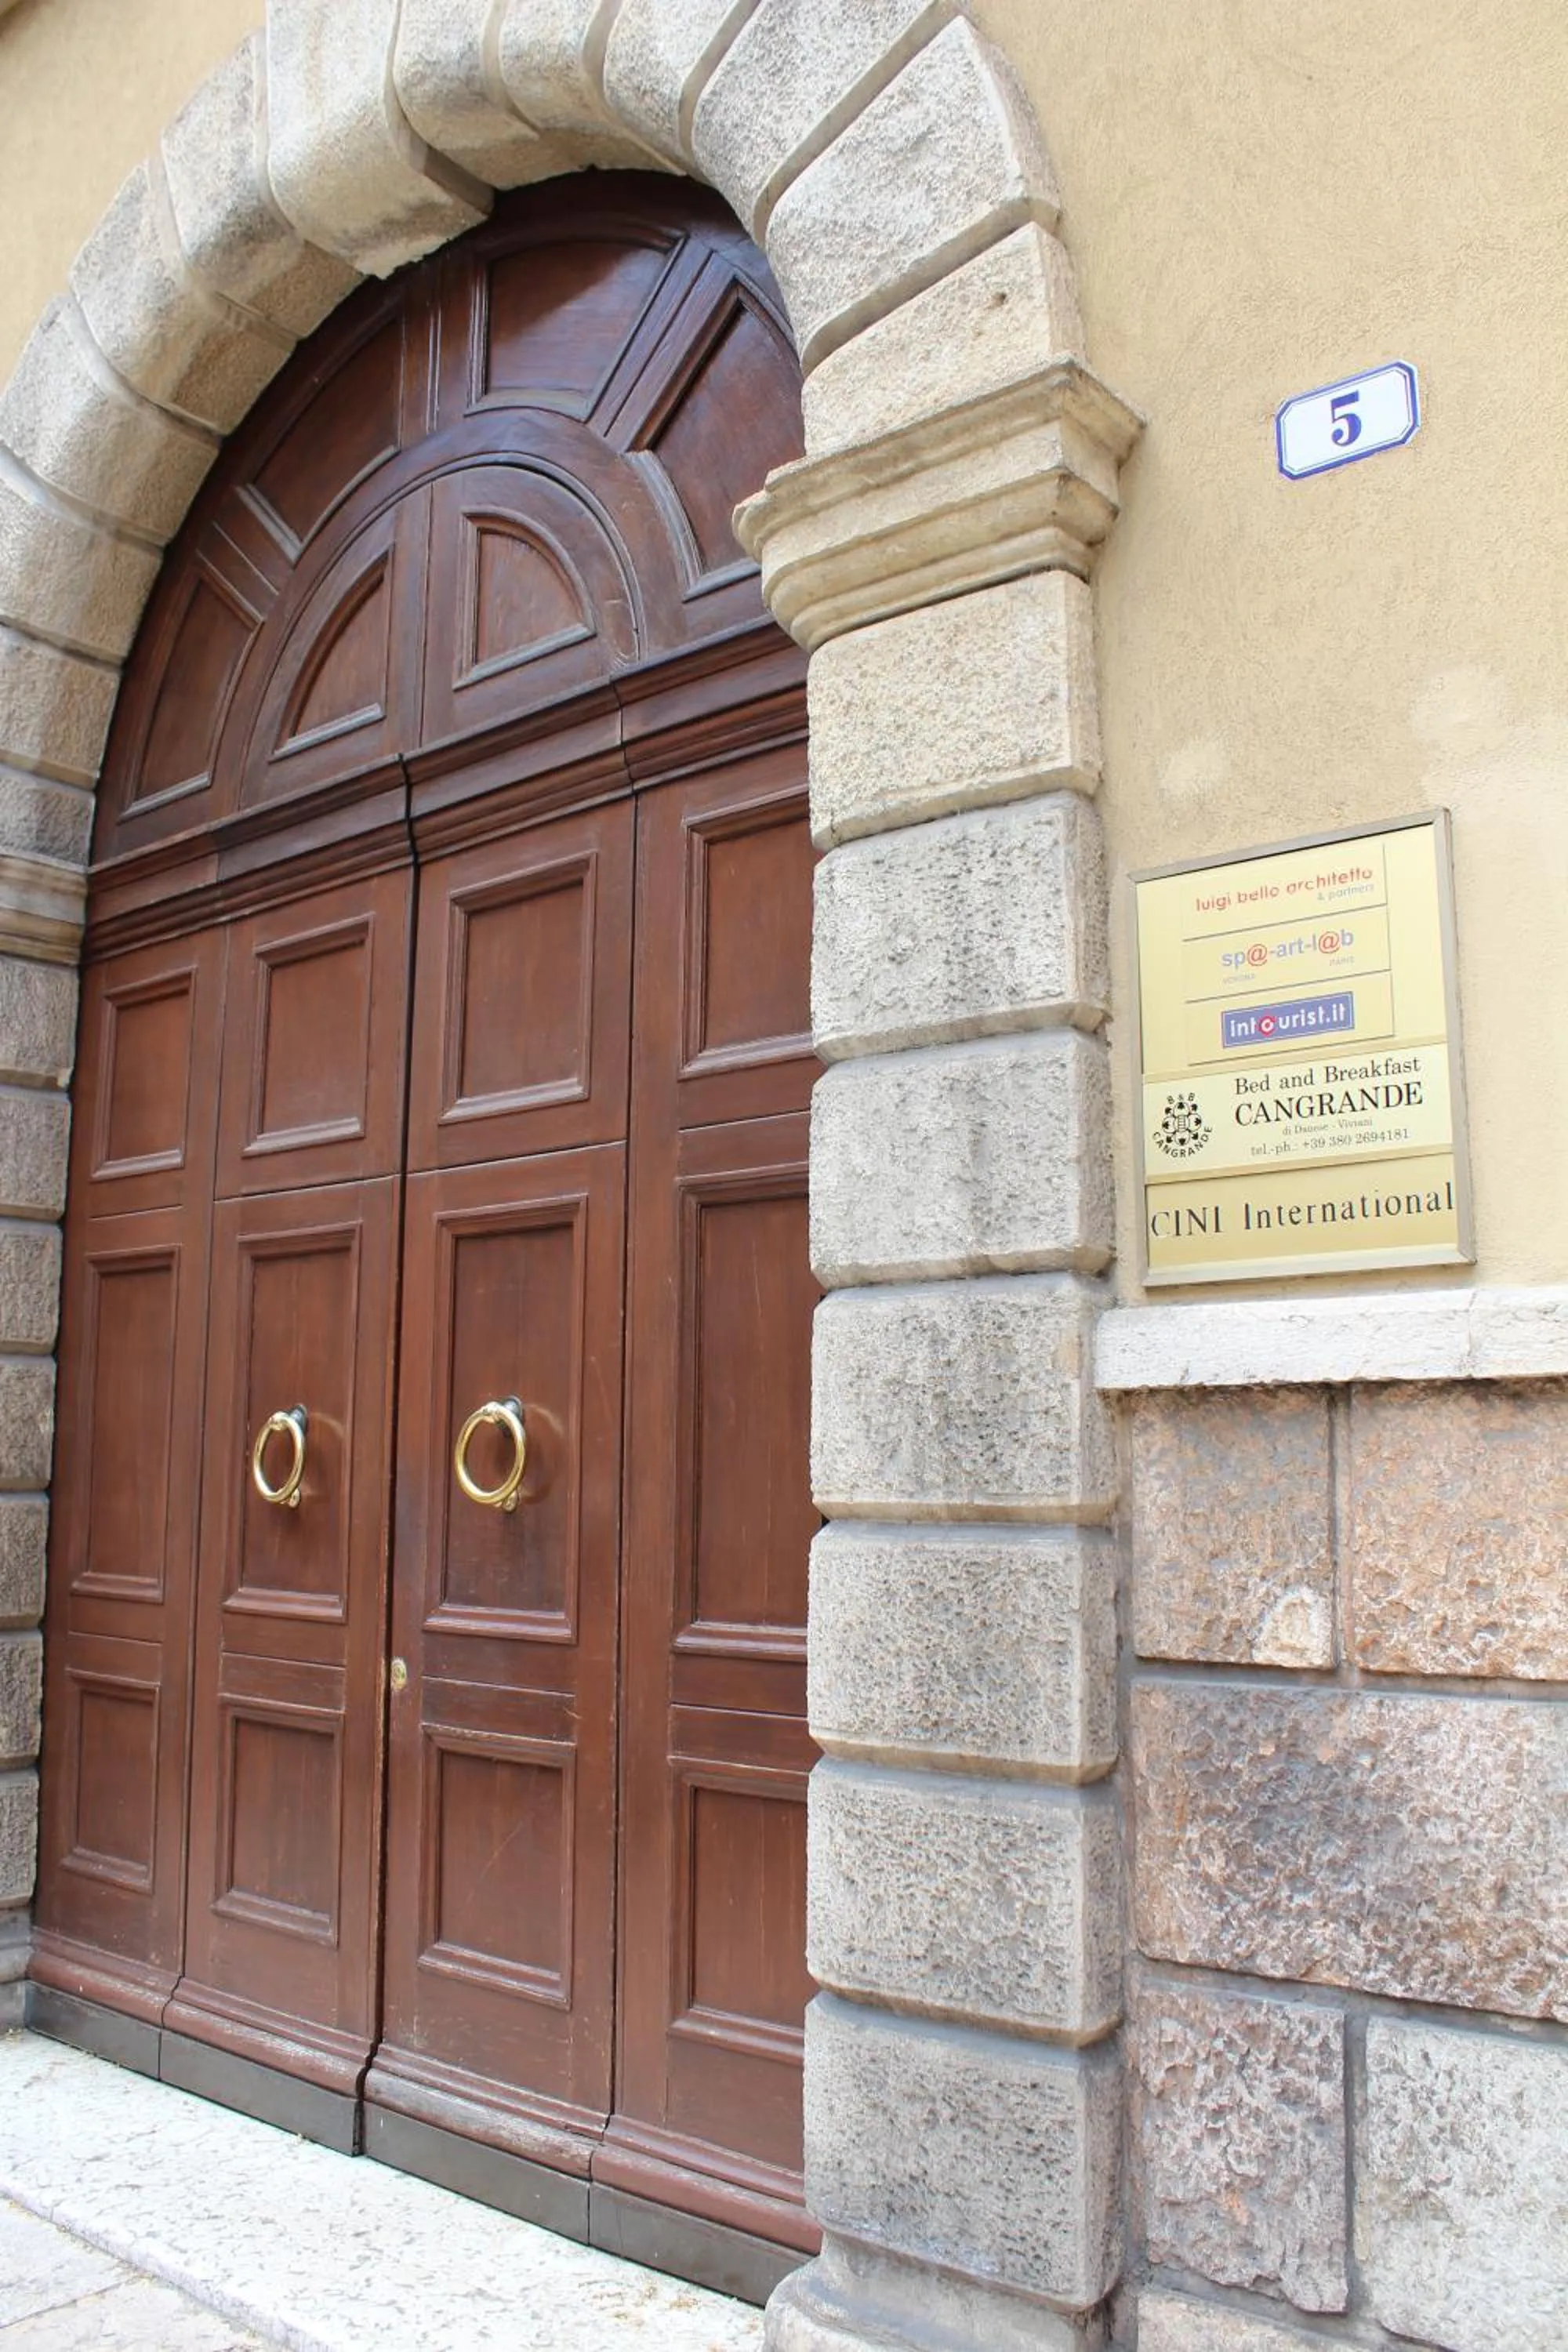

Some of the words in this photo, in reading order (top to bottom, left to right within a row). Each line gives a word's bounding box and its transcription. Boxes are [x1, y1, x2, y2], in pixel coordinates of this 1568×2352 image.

[1330, 390, 1362, 446] 5
[1196, 892, 1232, 912] luigi
[1237, 885, 1279, 905] bello
[1287, 867, 1373, 895] architetto
[1329, 883, 1374, 902] partners
[1235, 1076, 1270, 1095] Bed
[1279, 1068, 1315, 1090] and
[1325, 1056, 1421, 1083] Breakfast
[1235, 1081, 1424, 1127] CANGRANDE
[1283, 1124, 1292, 1136] di
[1303, 1134, 1327, 1151] +39
[1151, 1205, 1221, 1237] CINI
[1244, 1181, 1454, 1230] International
